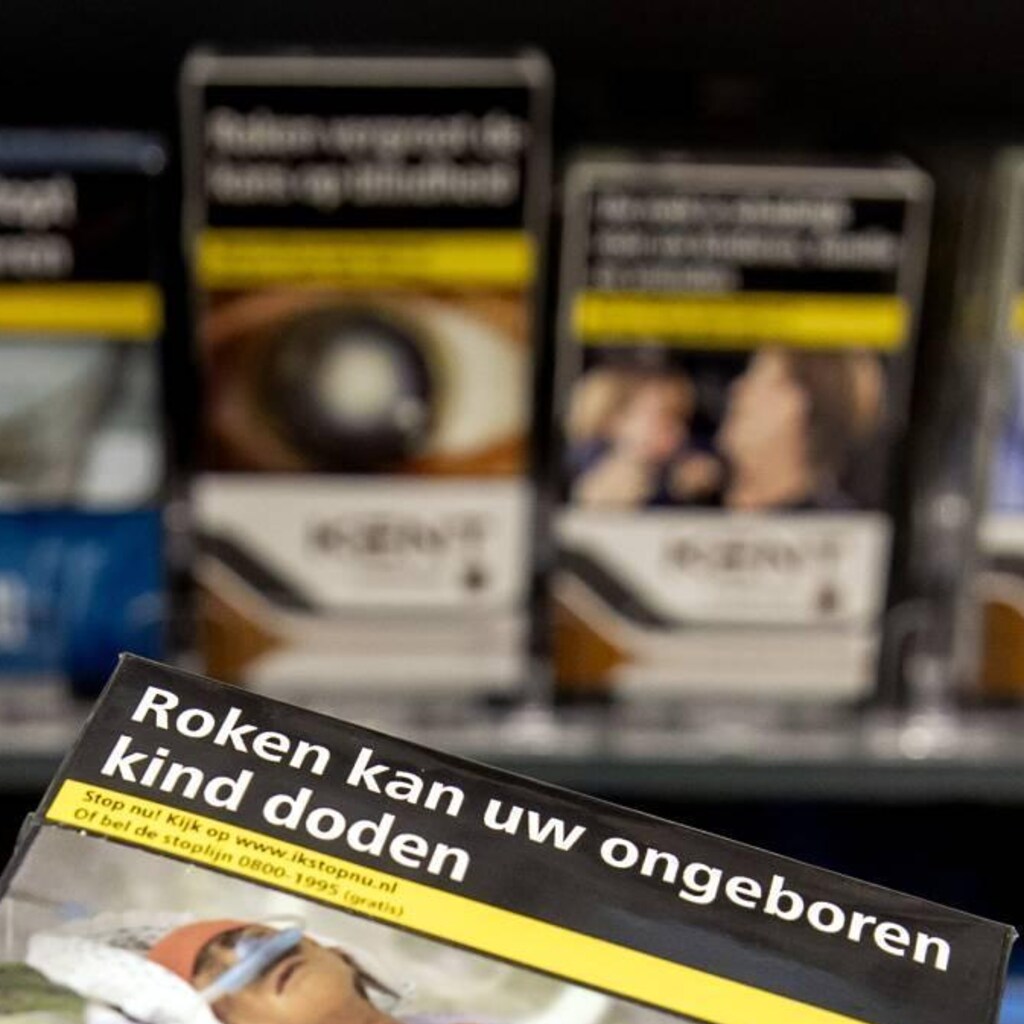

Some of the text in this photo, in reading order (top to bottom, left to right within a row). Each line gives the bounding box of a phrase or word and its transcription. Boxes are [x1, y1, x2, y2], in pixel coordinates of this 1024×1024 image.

[73, 807, 405, 918] Of bel de stoplijn 0800-1995 (gratis)
[84, 788, 399, 896] Stop nu! Kijk op www.ikstopnu.nl
[100, 735, 471, 883] kind doden
[131, 686, 951, 971] Roken kan uw ongeboren
